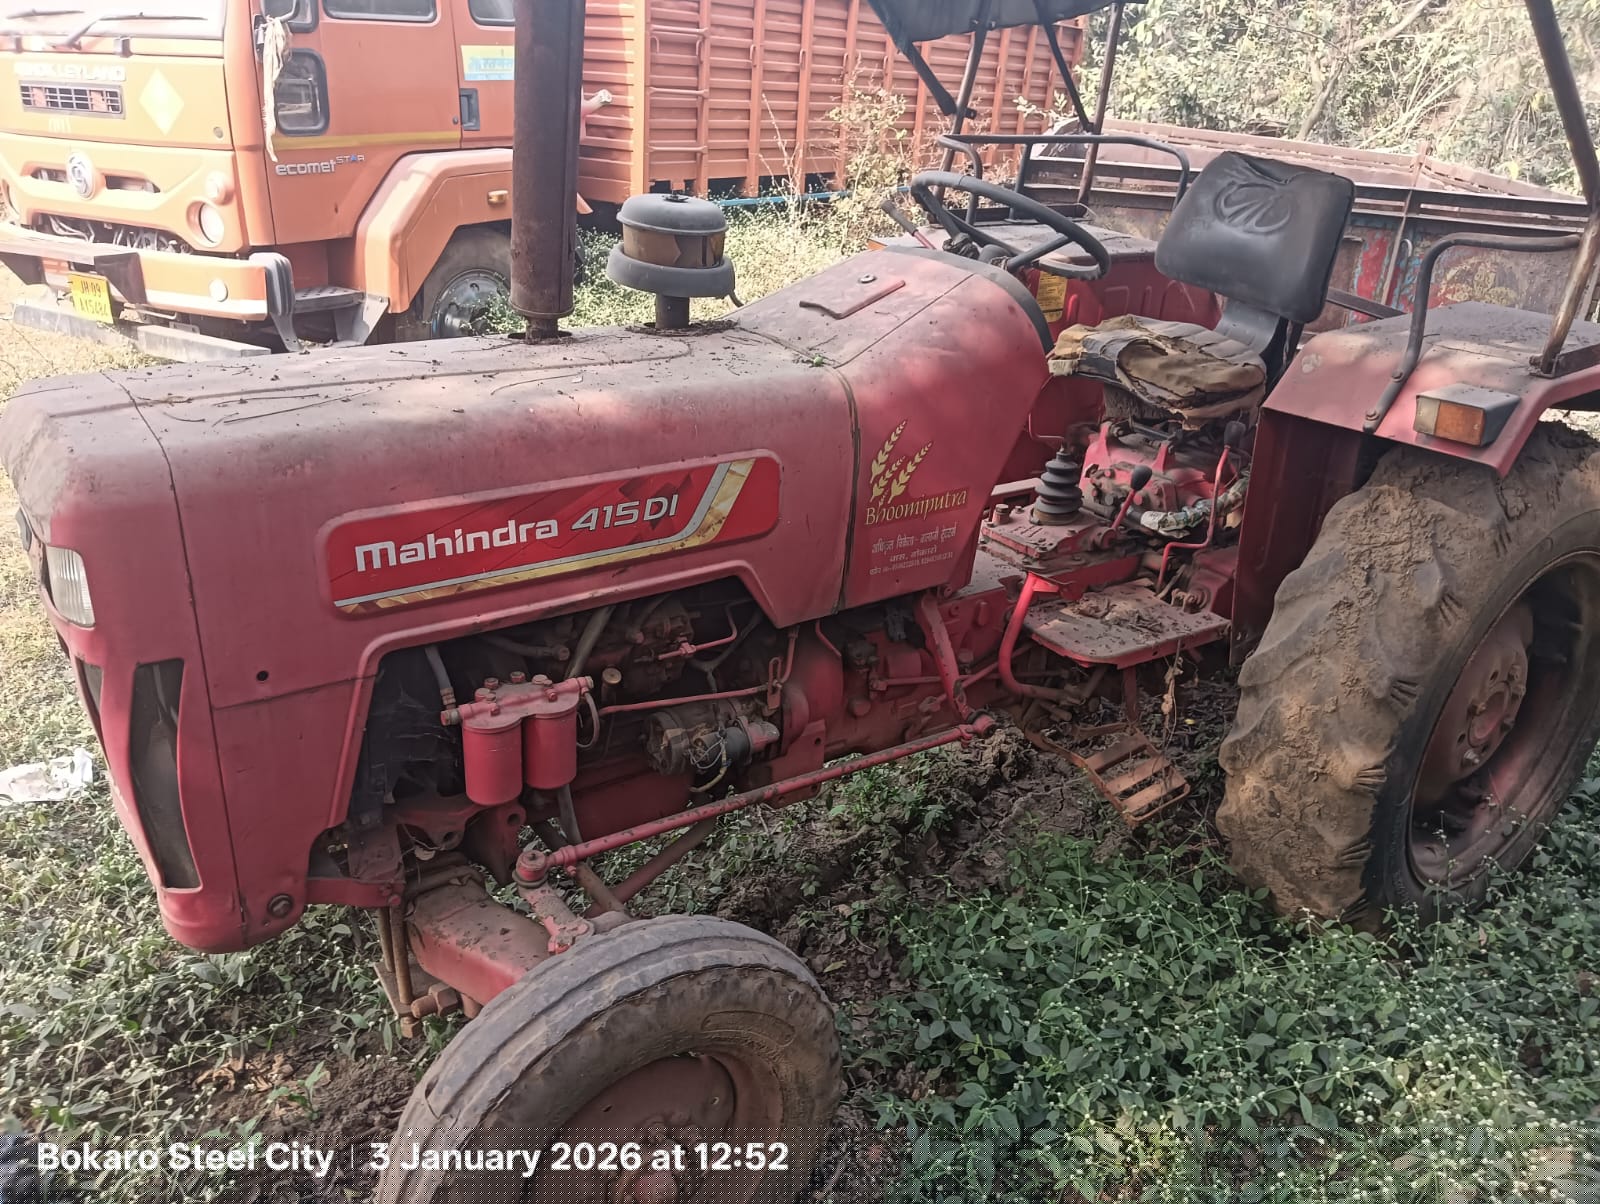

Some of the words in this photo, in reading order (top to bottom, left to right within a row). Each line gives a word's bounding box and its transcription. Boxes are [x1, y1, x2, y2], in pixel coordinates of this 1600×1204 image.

[275, 159, 336, 176] ecomet
[865, 490, 967, 525] Bhoomiputra
[354, 518, 559, 573] Mahindra
